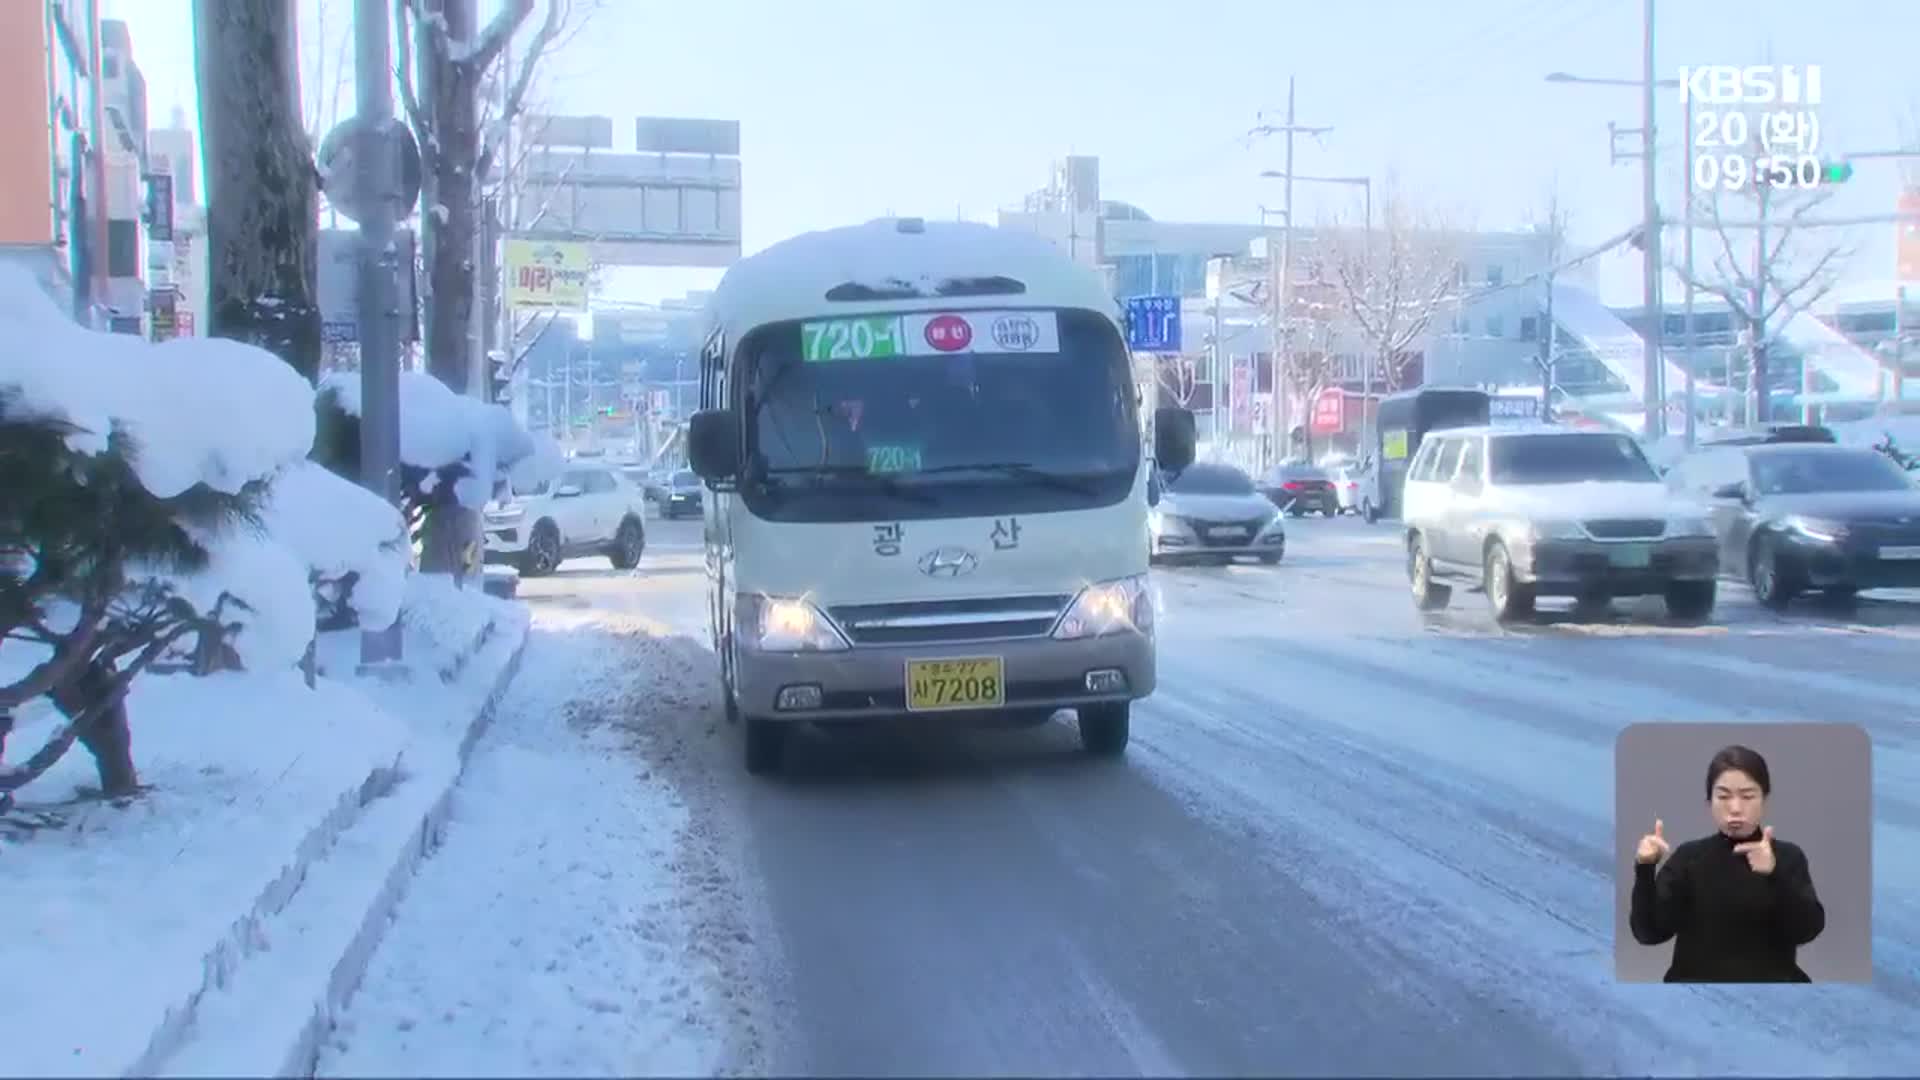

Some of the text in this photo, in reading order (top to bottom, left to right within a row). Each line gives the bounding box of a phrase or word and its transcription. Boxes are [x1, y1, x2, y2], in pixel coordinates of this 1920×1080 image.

[804, 320, 903, 360] 720-1
[866, 446, 922, 475] 720-1
[873, 517, 1021, 557] 광 산
